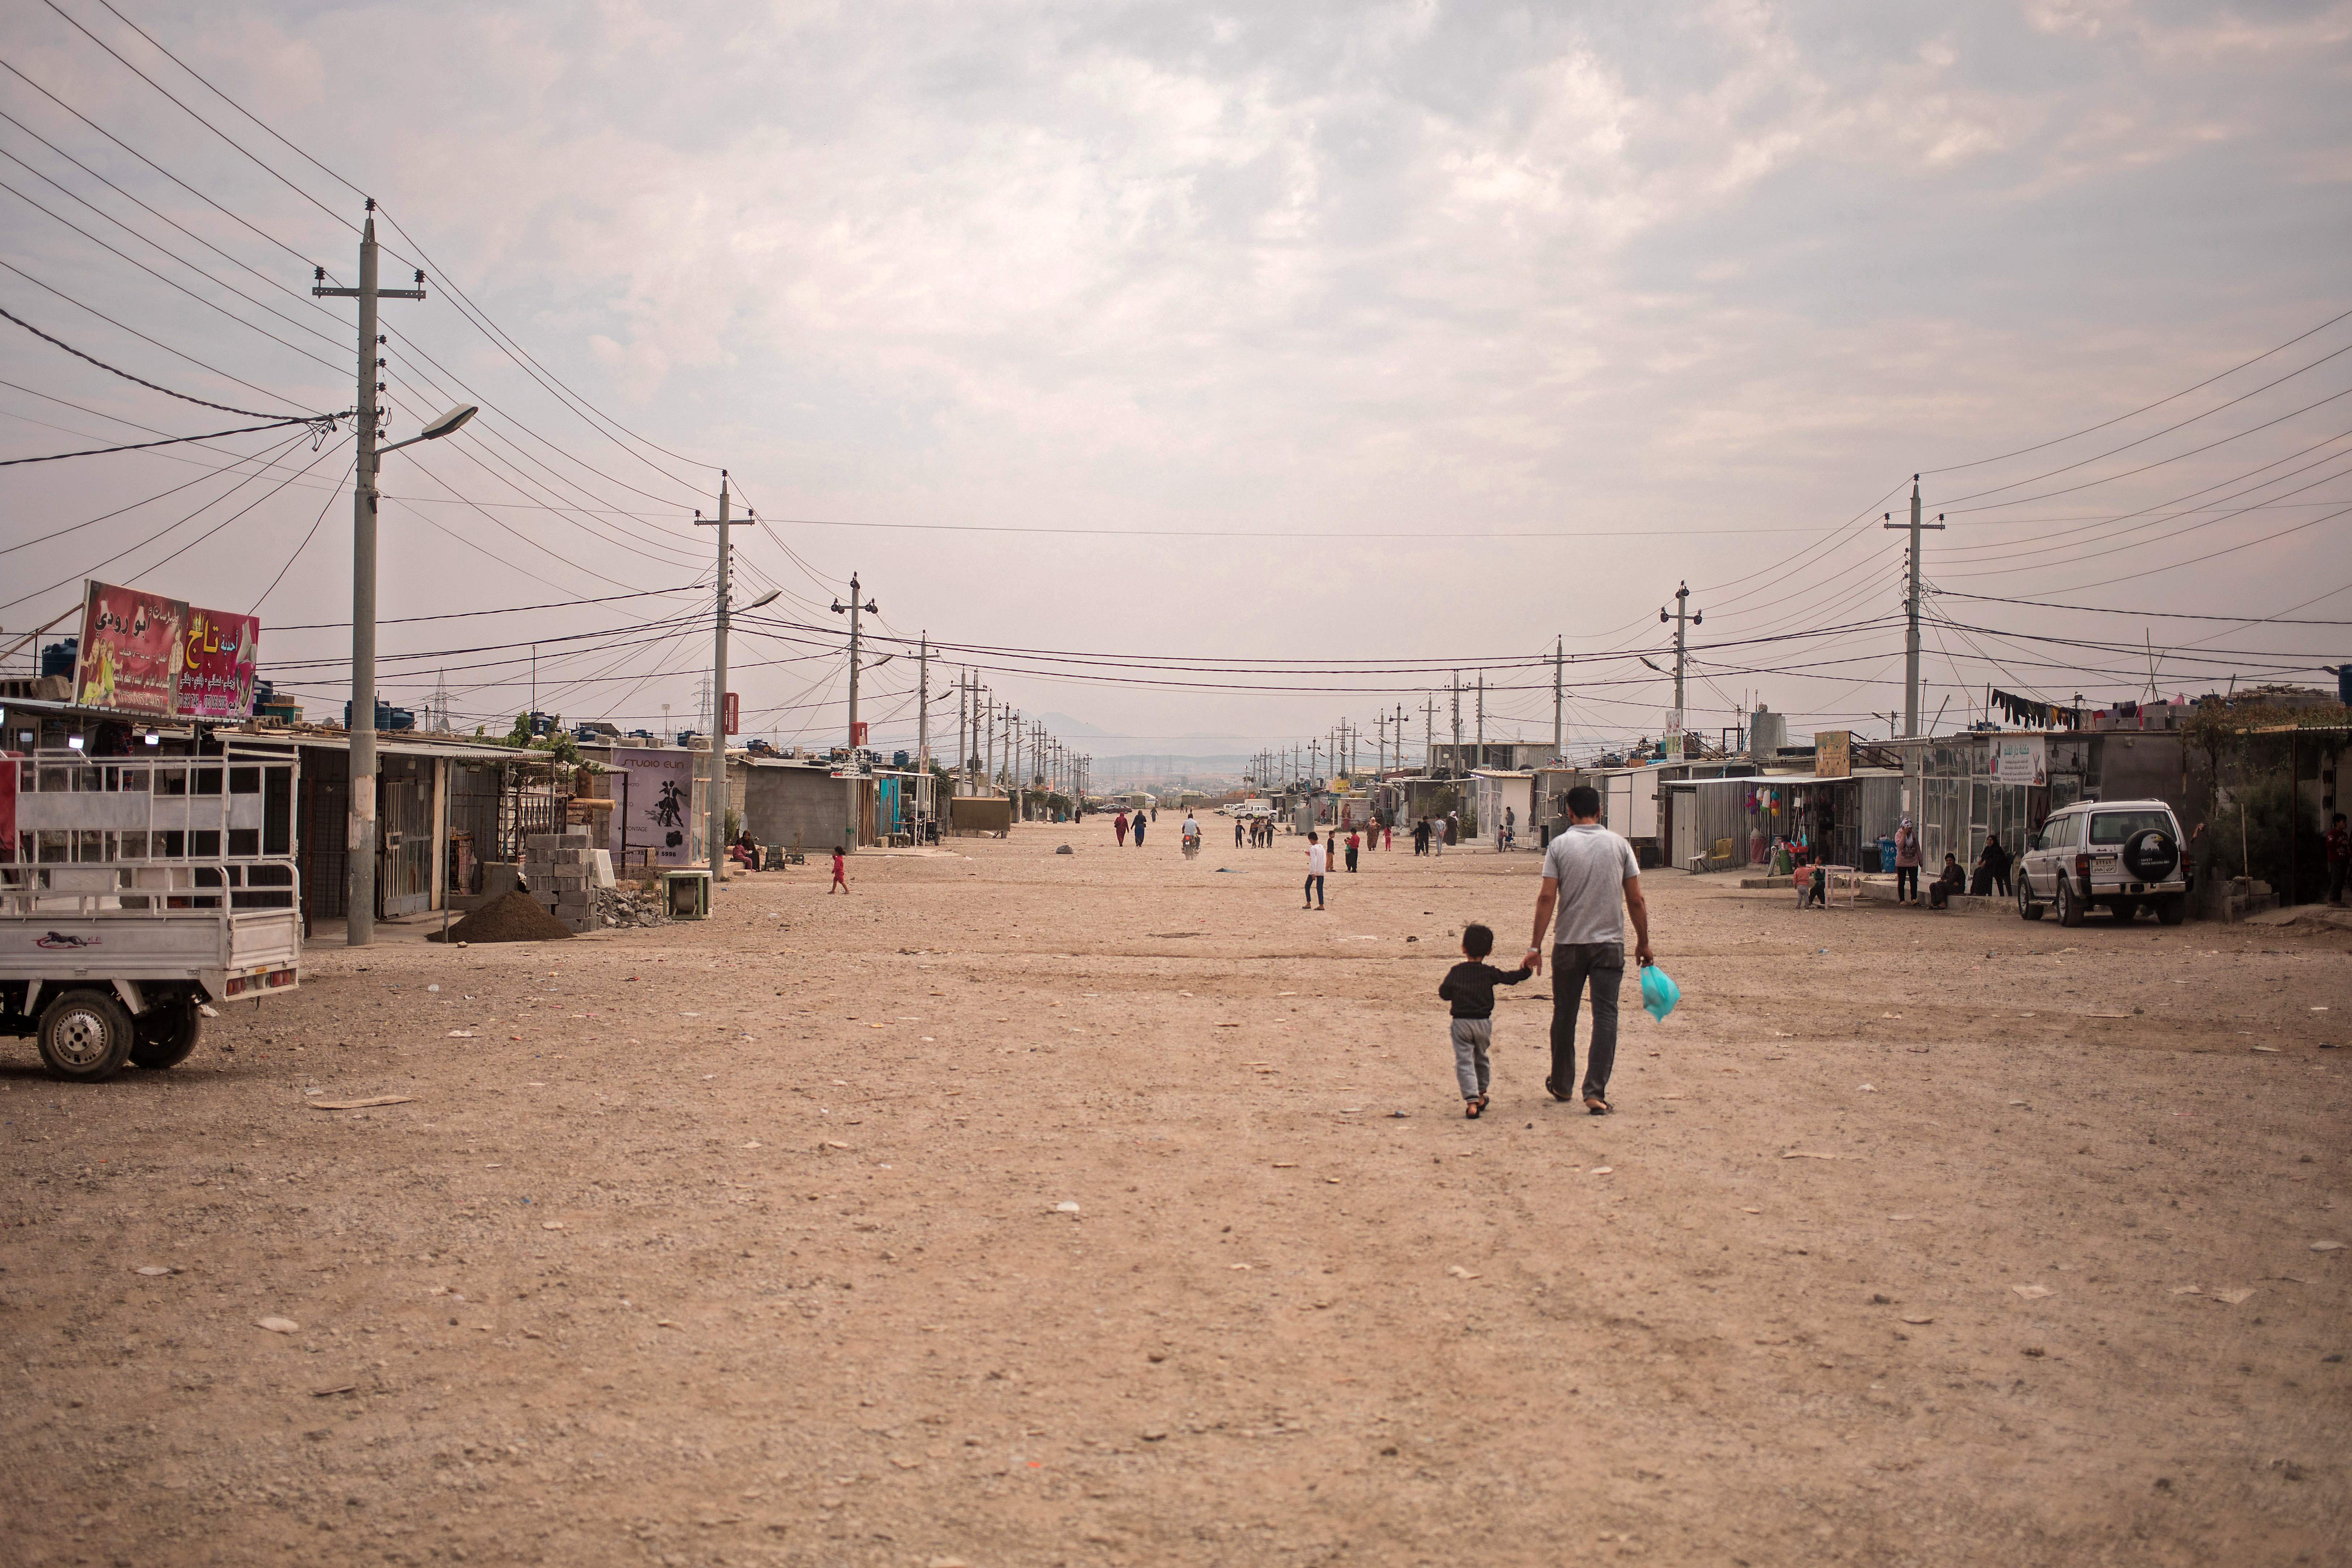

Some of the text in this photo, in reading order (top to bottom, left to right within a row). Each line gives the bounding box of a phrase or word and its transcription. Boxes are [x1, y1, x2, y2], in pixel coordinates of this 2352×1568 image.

[133, 607, 152, 640] أبو
[186, 619, 238, 669] أحذية تاج
[621, 759, 660, 767] STUDIO
